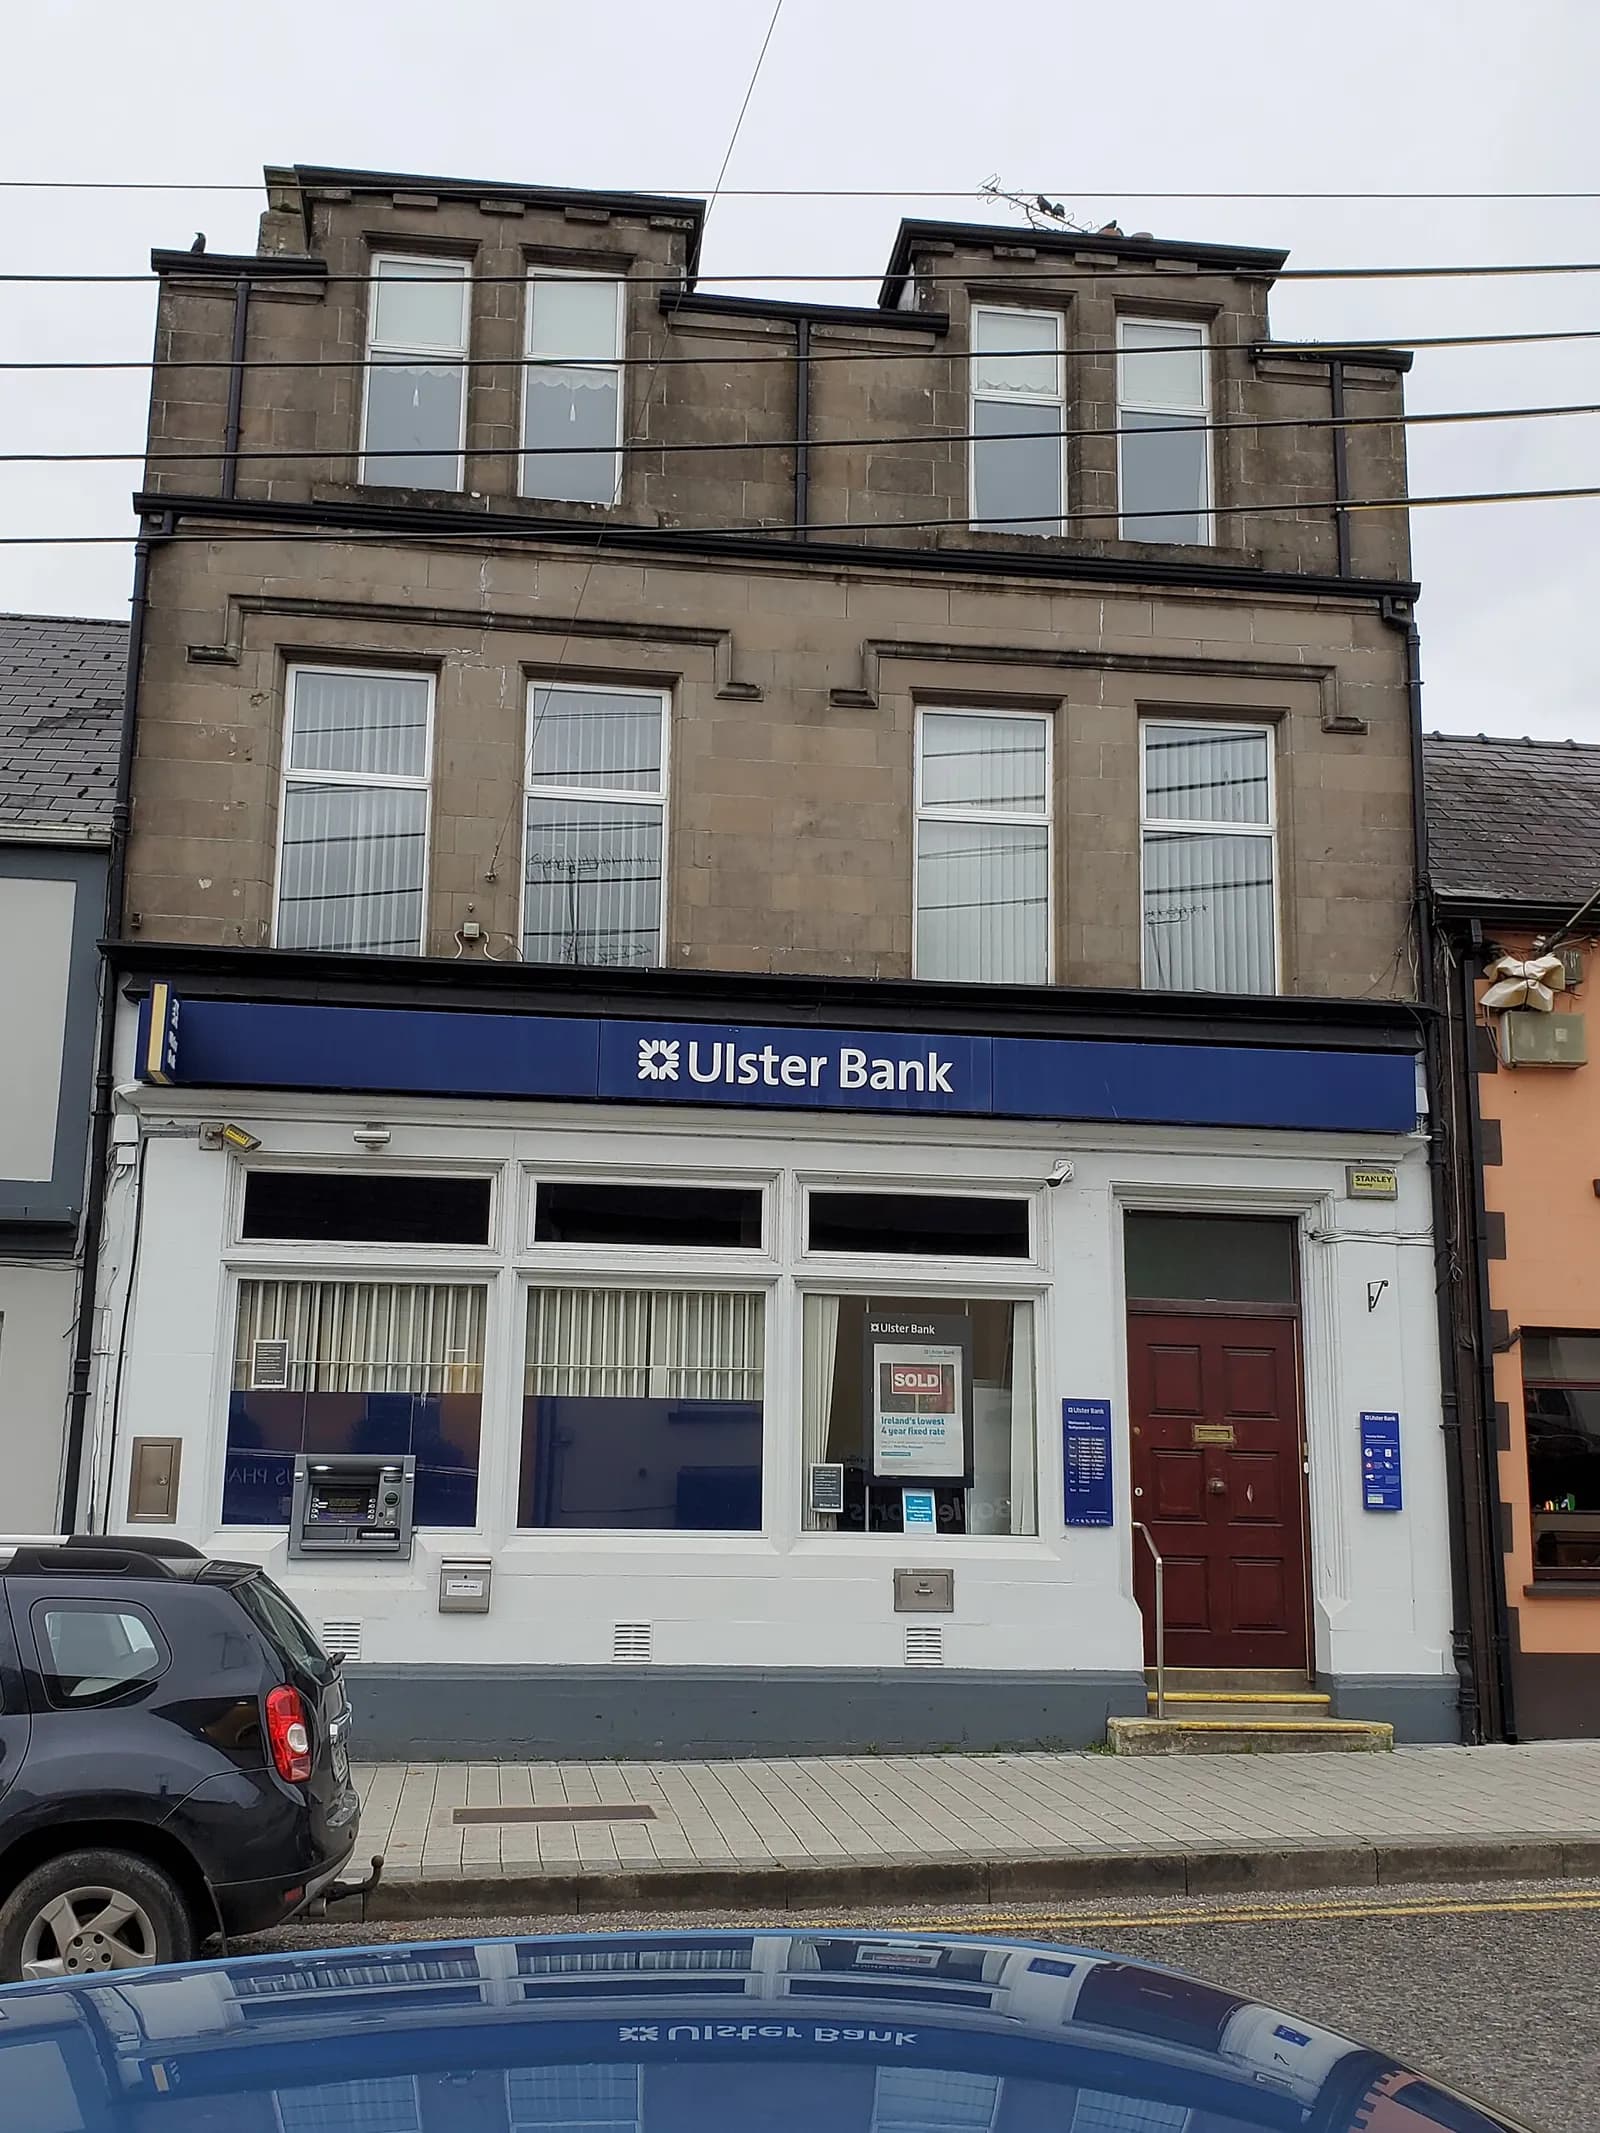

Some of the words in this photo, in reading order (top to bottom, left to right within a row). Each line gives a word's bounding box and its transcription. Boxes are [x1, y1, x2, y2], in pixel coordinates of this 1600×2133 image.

[688, 1040, 827, 1087] Ulster
[839, 1047, 954, 1093] Bank
[1355, 1175, 1392, 1183] STANLEY
[880, 1323, 909, 1333] Ulster
[911, 1324, 935, 1335] Bank
[894, 1373, 939, 1388] SOLD
[881, 1416, 916, 1425] Ireland's
[917, 1416, 945, 1426] lowest
[881, 1426, 887, 1434] 4
[888, 1428, 906, 1436] year
[907, 1427, 928, 1435] fixed
[929, 1428, 945, 1436] rate
